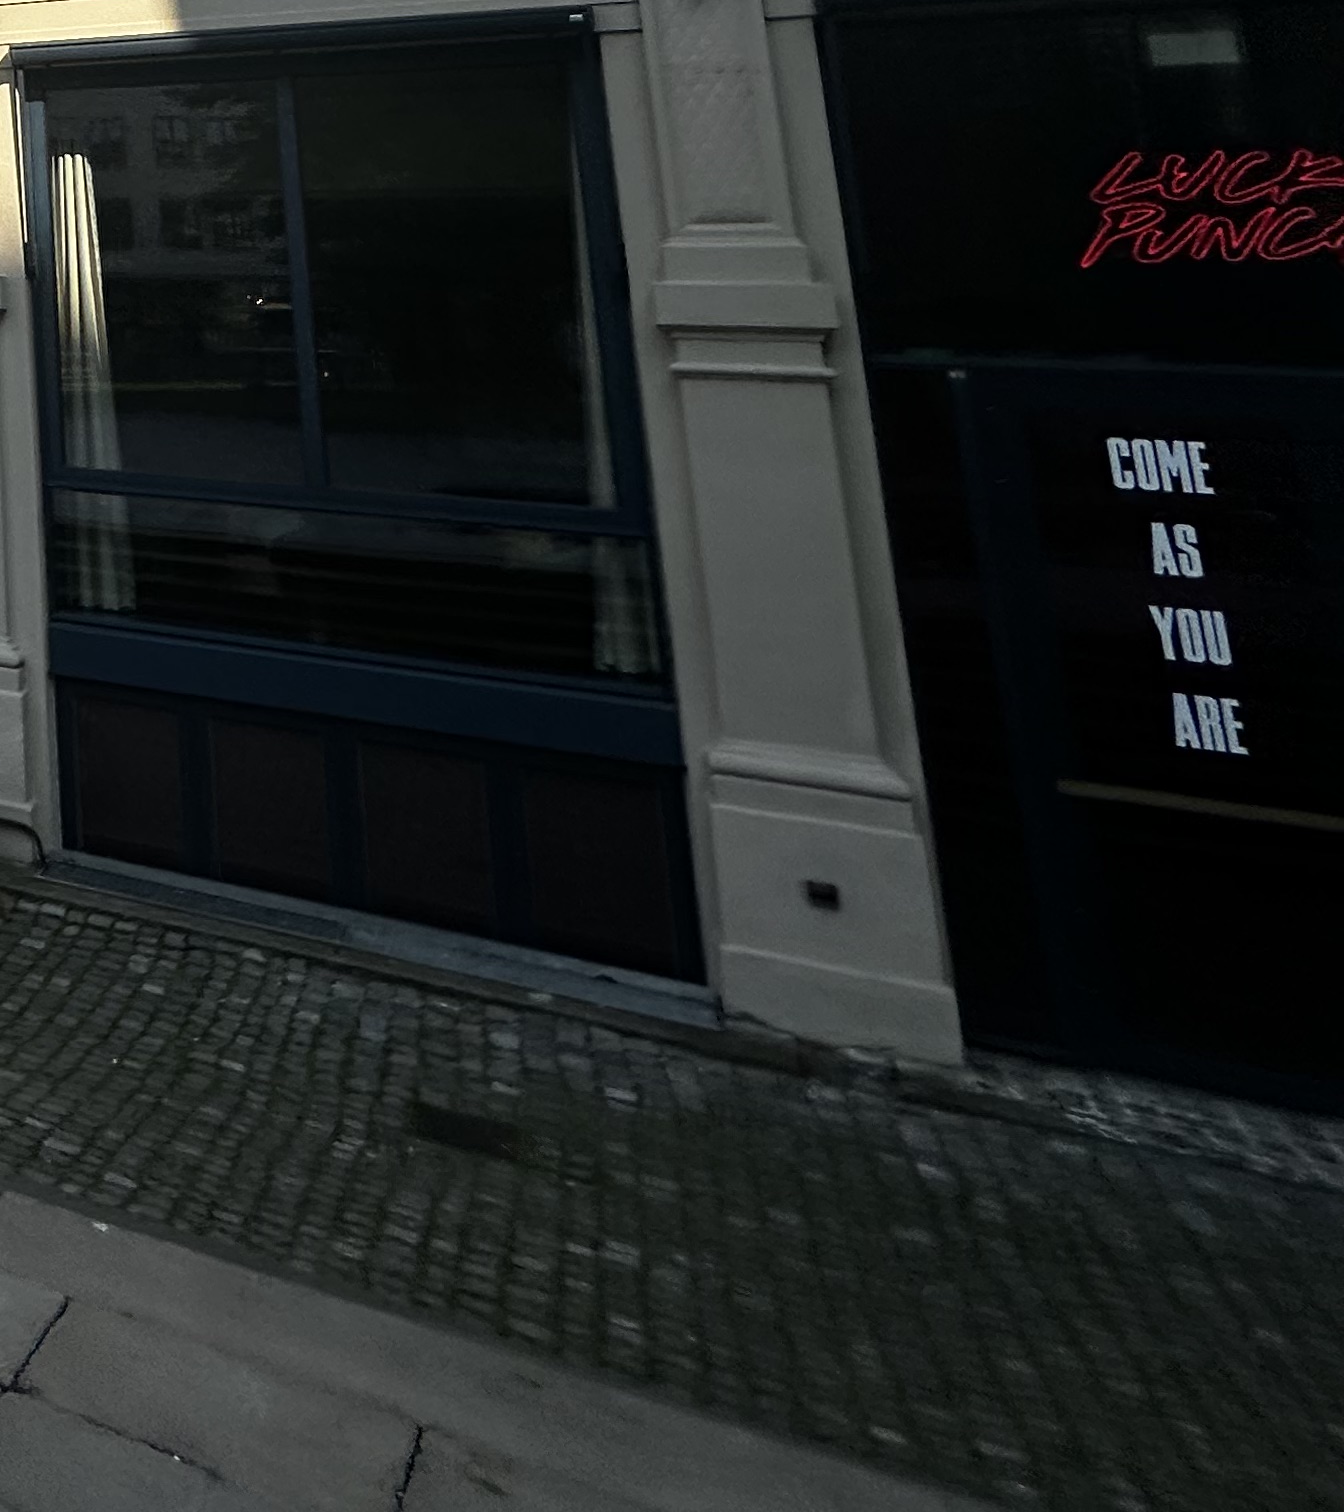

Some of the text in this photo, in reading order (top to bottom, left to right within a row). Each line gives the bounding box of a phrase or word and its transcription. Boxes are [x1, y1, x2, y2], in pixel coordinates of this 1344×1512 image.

[1080, 201, 1344, 269] PUNC
[1106, 437, 1216, 495] COME
[1150, 522, 1204, 578] AS
[1148, 604, 1233, 666] YOU
[1172, 692, 1250, 756] ARE
